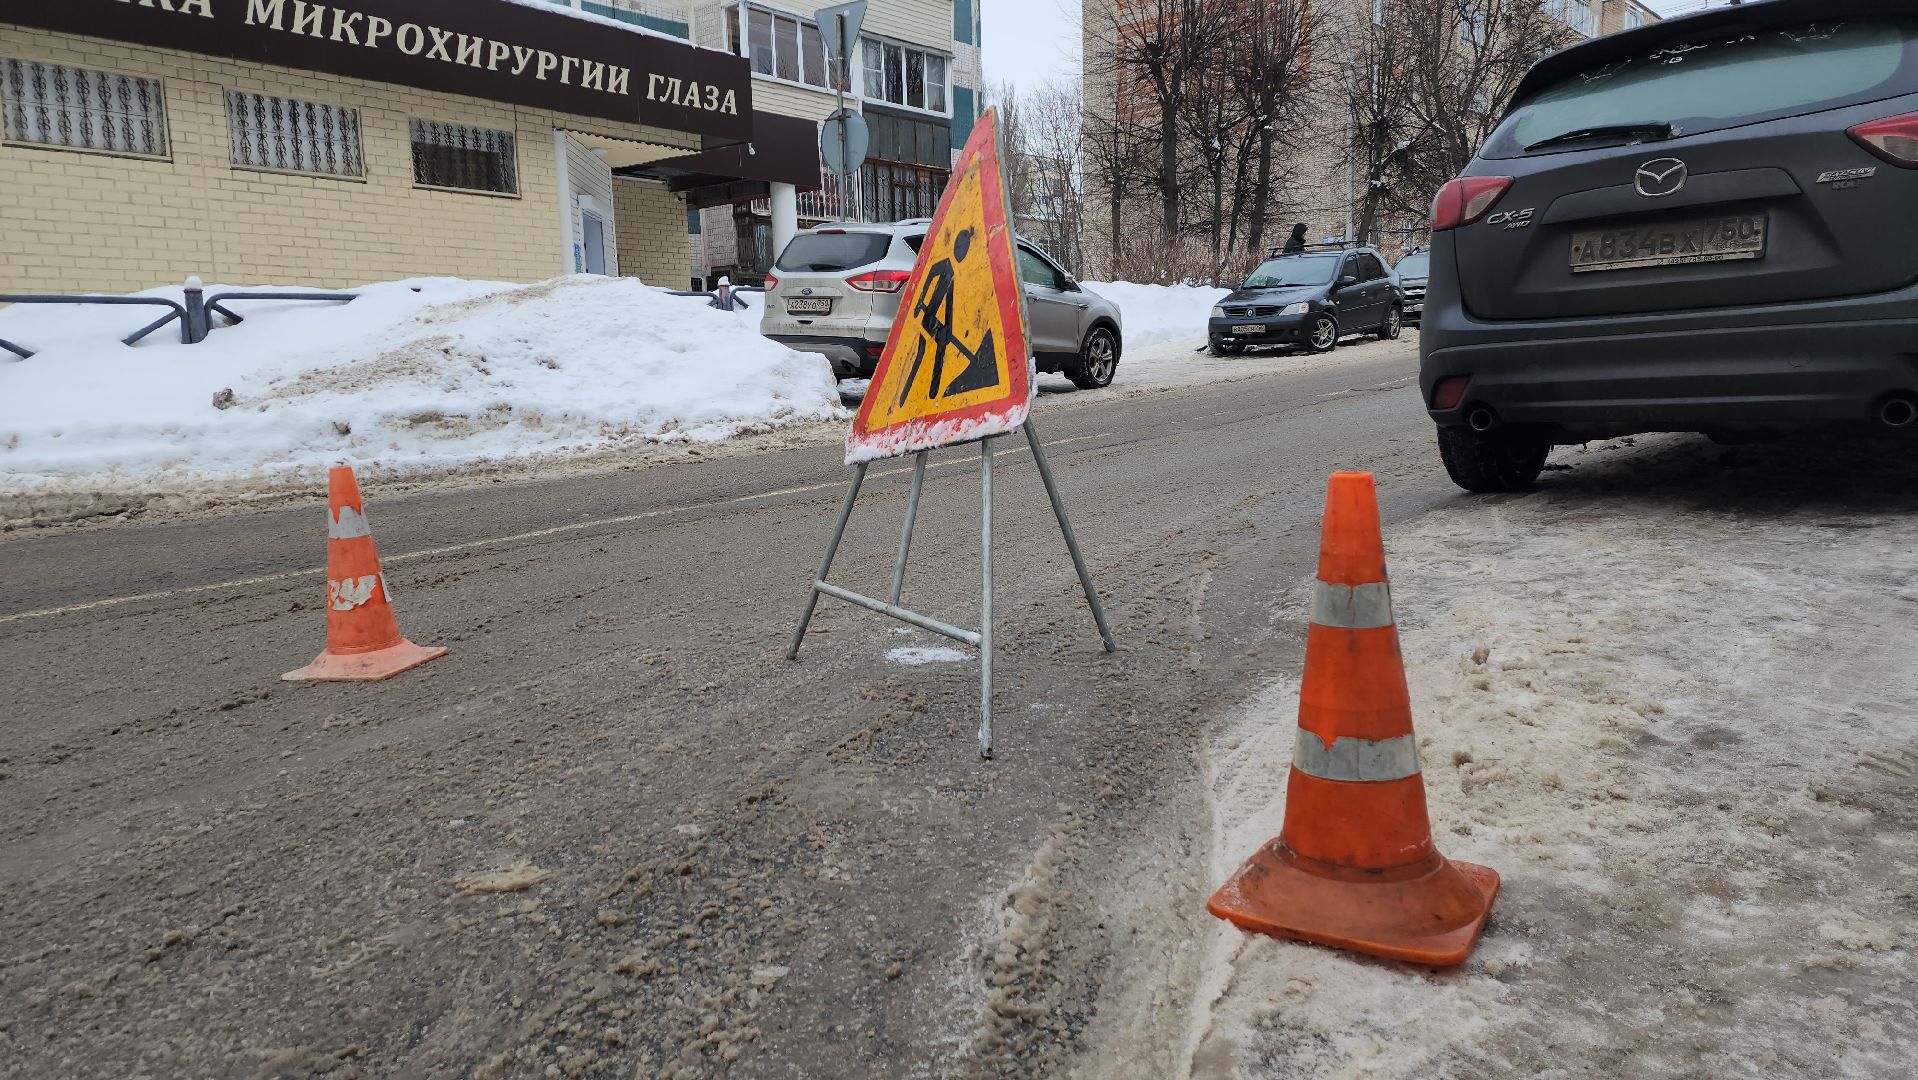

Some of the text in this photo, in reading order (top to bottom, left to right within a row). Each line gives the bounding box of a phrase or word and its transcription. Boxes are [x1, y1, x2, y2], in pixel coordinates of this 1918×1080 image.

[244, 0, 738, 116] МИКРОХИРУРГИИ ГЛАЗА
[1487, 207, 1535, 225] CX-5
